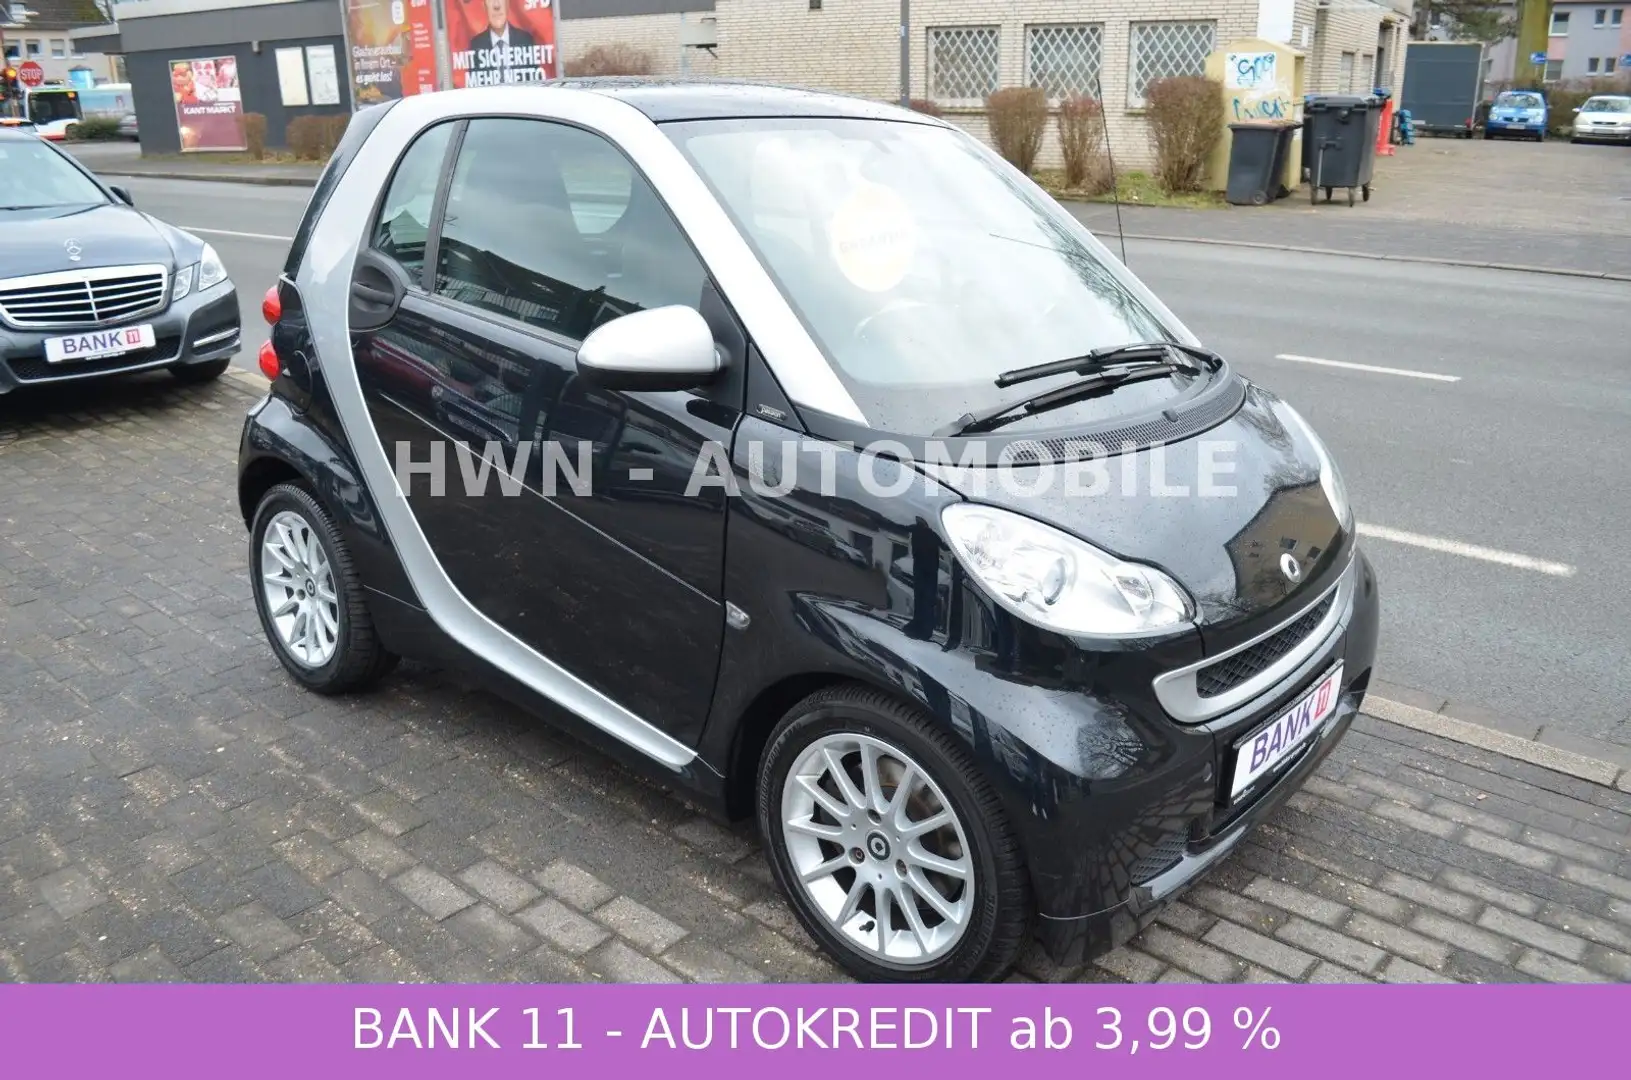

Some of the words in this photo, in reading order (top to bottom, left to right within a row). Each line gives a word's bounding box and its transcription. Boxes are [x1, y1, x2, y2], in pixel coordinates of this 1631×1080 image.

[453, 51, 475, 69] MIT
[478, 44, 554, 68] SICHERHEIT
[20, 68, 42, 80] STOP
[465, 71, 500, 88] MEHR
[503, 67, 546, 84] NETTO
[62, 332, 122, 354] BANK
[1249, 695, 1315, 774] BANK
